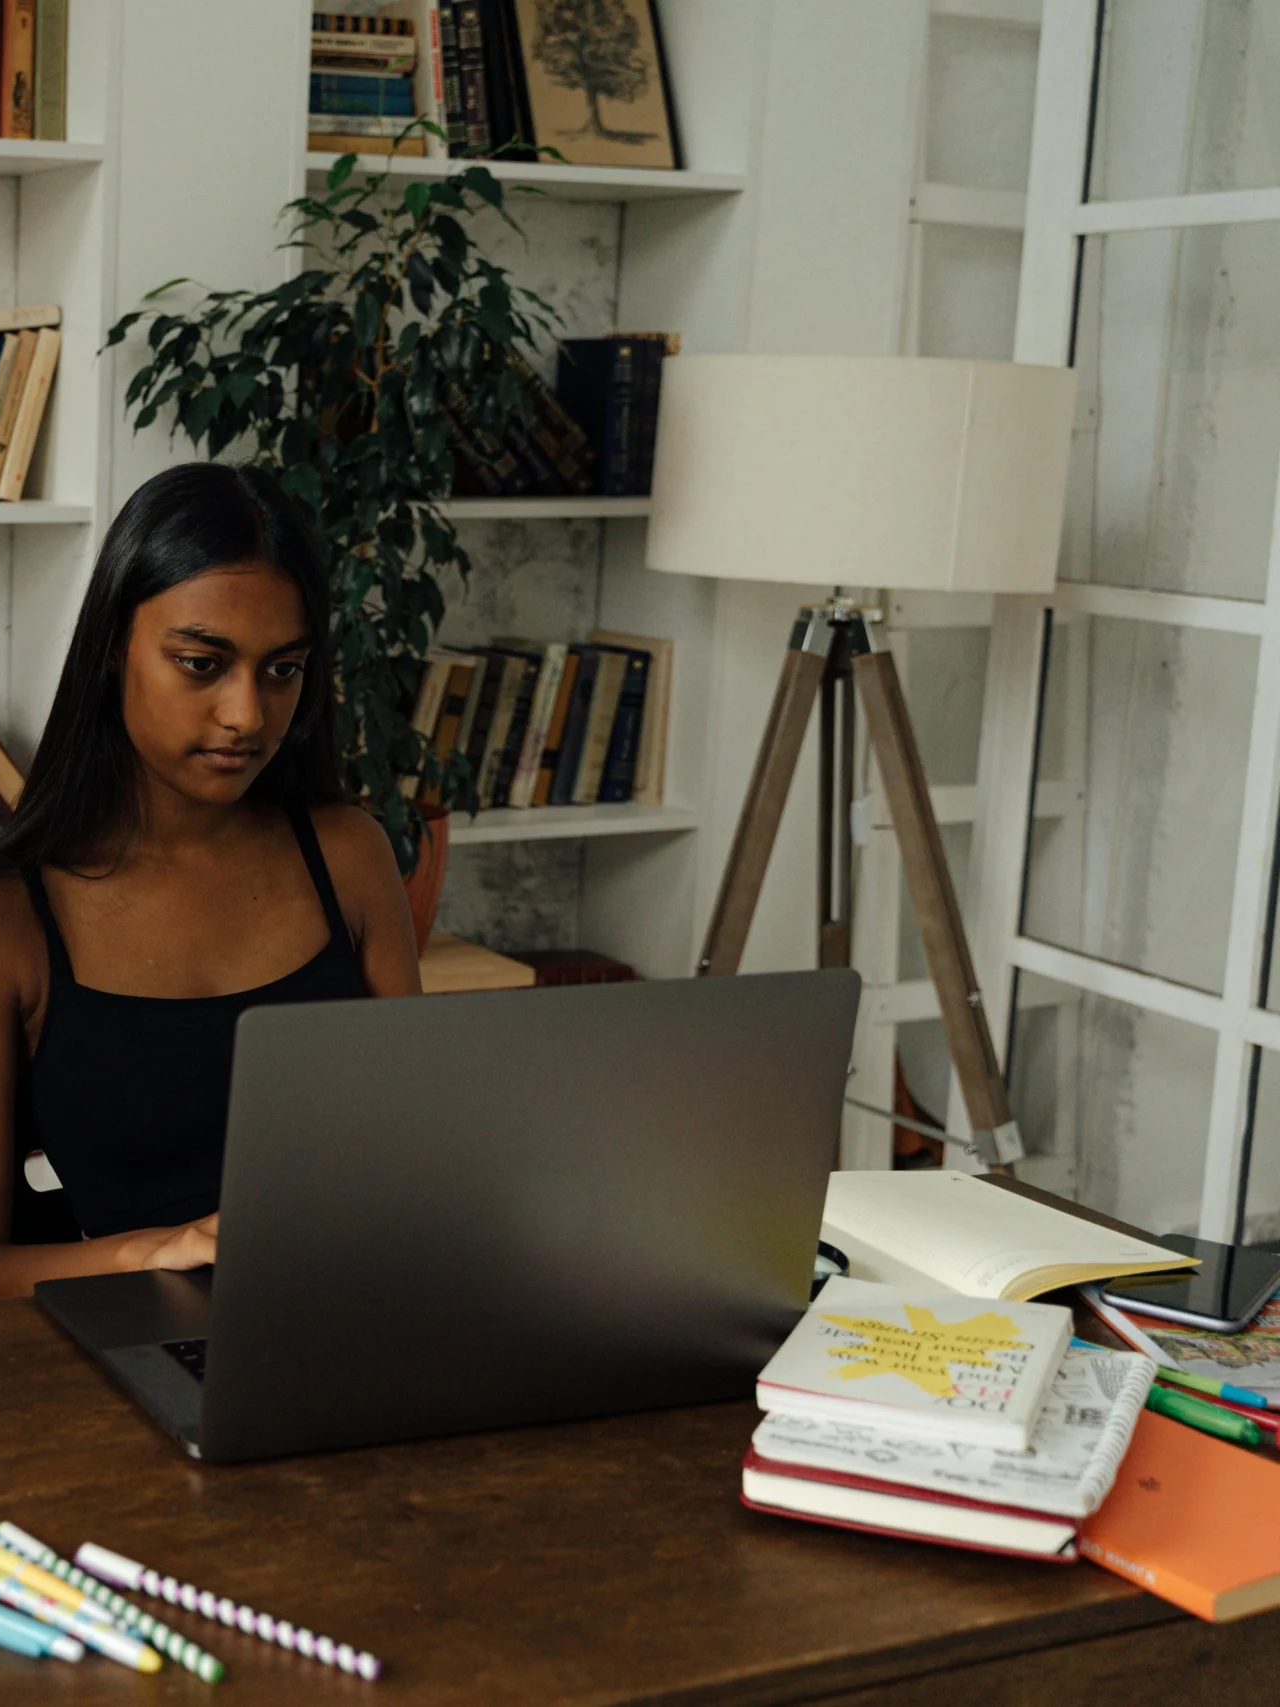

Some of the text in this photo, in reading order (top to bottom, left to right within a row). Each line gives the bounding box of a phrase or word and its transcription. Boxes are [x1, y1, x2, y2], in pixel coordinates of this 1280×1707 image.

[852, 1320, 1036, 1351] Gavin Strange
[873, 1335, 923, 1351] best
[927, 1354, 942, 1363] a
[932, 1344, 986, 1357] your
[892, 1361, 949, 1377] your
[949, 1358, 1023, 1377] Make
[956, 1370, 1019, 1388] Find
[949, 1383, 1013, 1401] FLY
